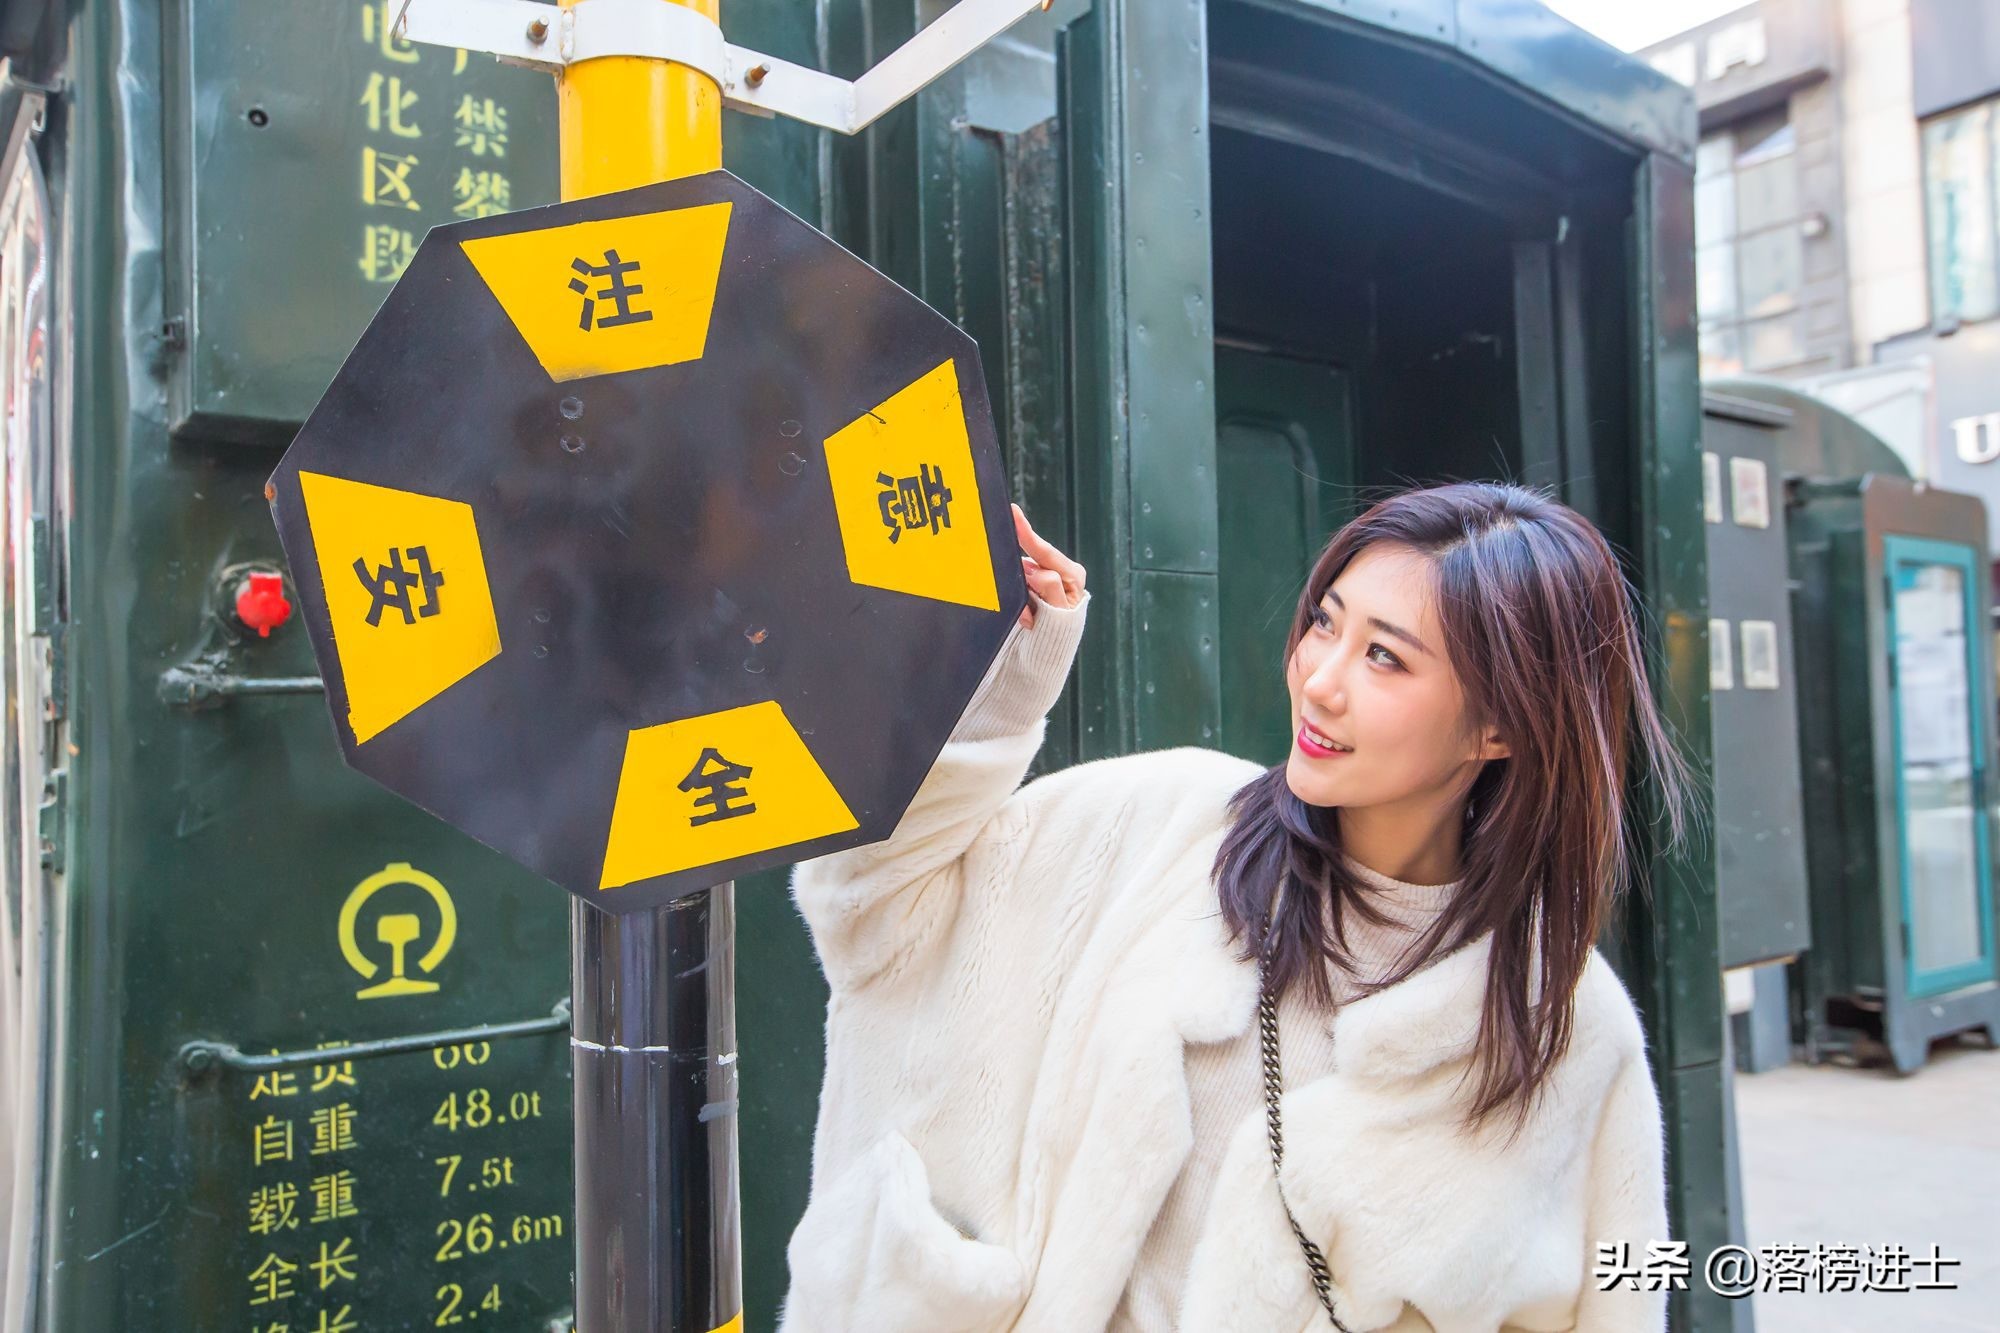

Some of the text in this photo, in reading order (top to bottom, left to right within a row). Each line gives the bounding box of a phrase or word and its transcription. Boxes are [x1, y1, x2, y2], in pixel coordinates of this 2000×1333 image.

[453, 48, 510, 217] 禁攀
[568, 249, 653, 332] 注
[876, 463, 952, 544] 意
[352, 545, 445, 627] 安
[677, 747, 756, 827] 全
[254, 1088, 541, 1166] 自重 48.0t
[248, 1155, 513, 1235] 载重 7.5t
[248, 1213, 562, 1305] 全长 26.6m
[435, 1283, 502, 1327] 2.4
